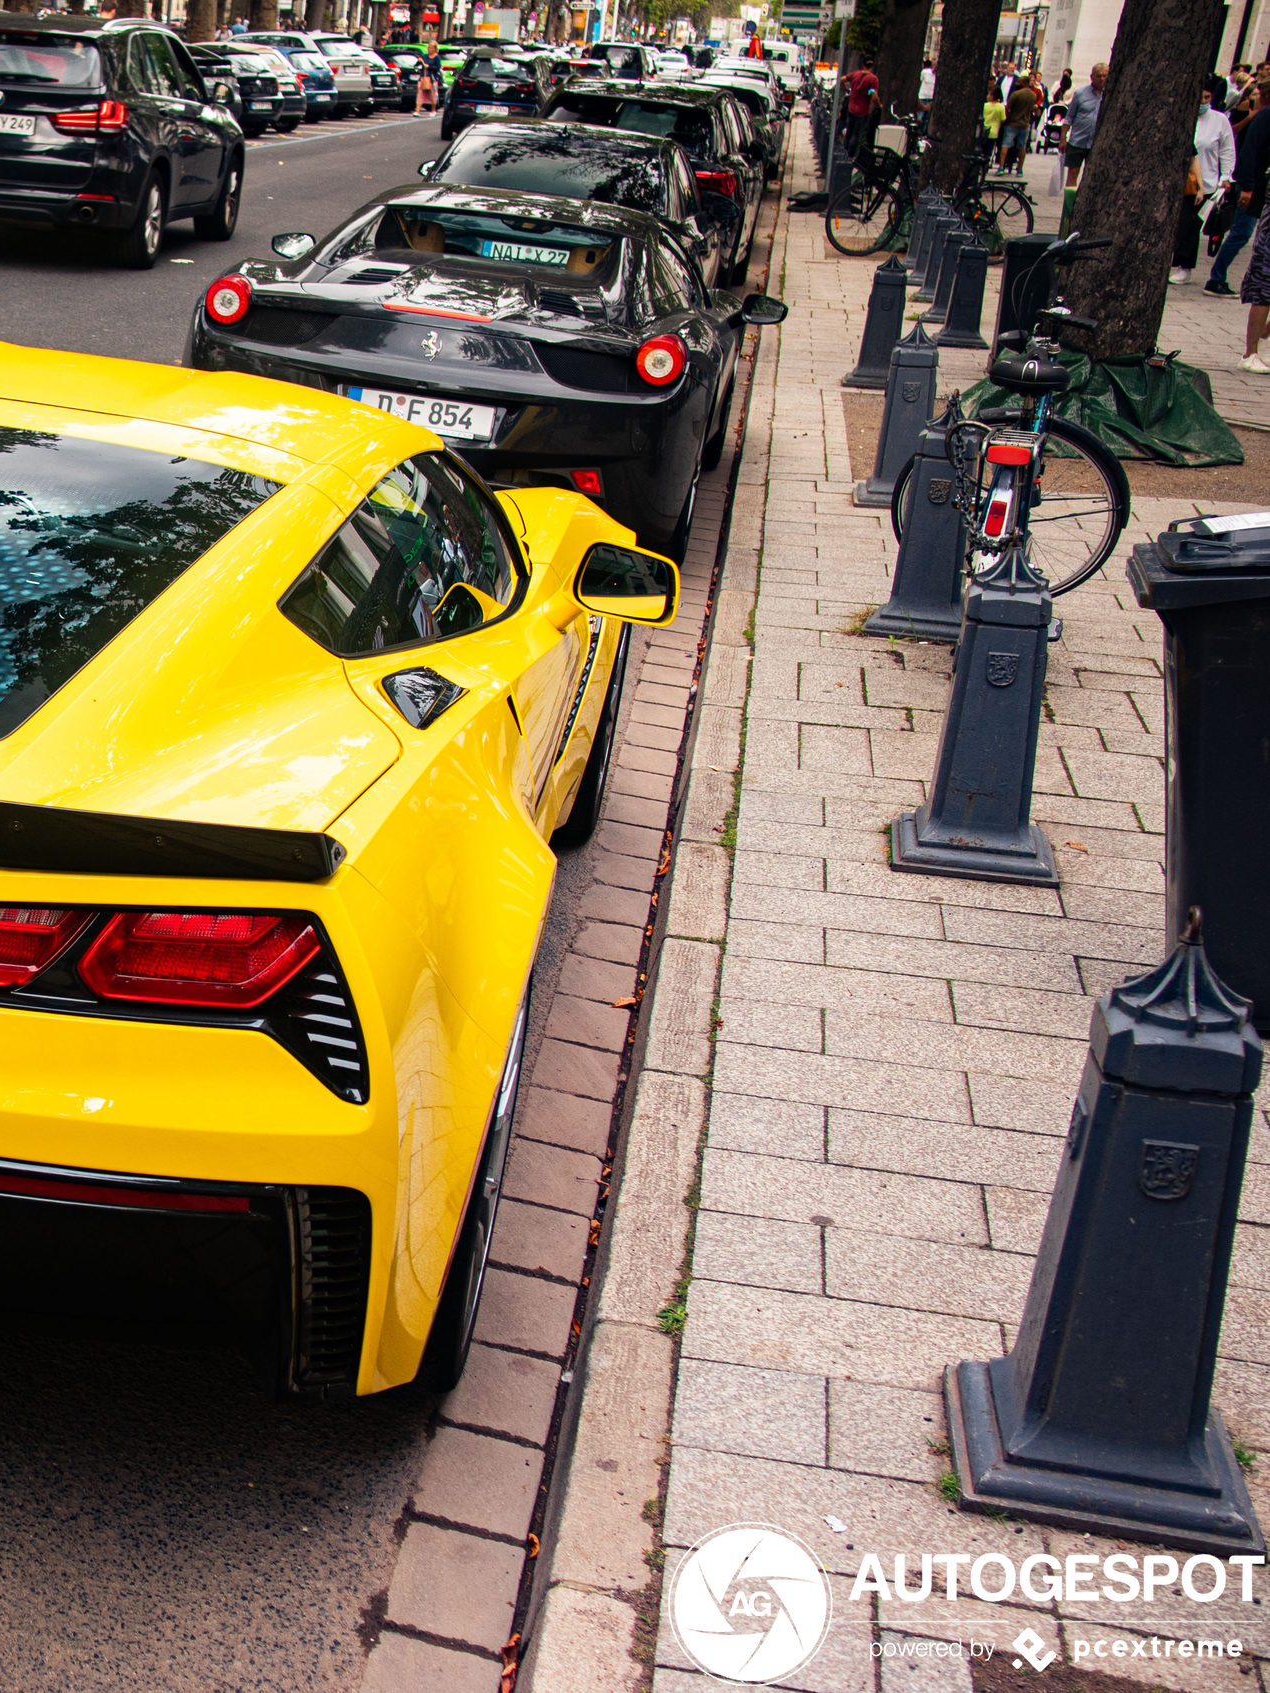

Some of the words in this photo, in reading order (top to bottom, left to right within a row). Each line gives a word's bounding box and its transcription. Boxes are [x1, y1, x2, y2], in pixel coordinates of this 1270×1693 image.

[10, 117, 33, 130] 249
[547, 250, 568, 264] 27
[407, 398, 425, 421] F
[428, 402, 474, 430] 854
